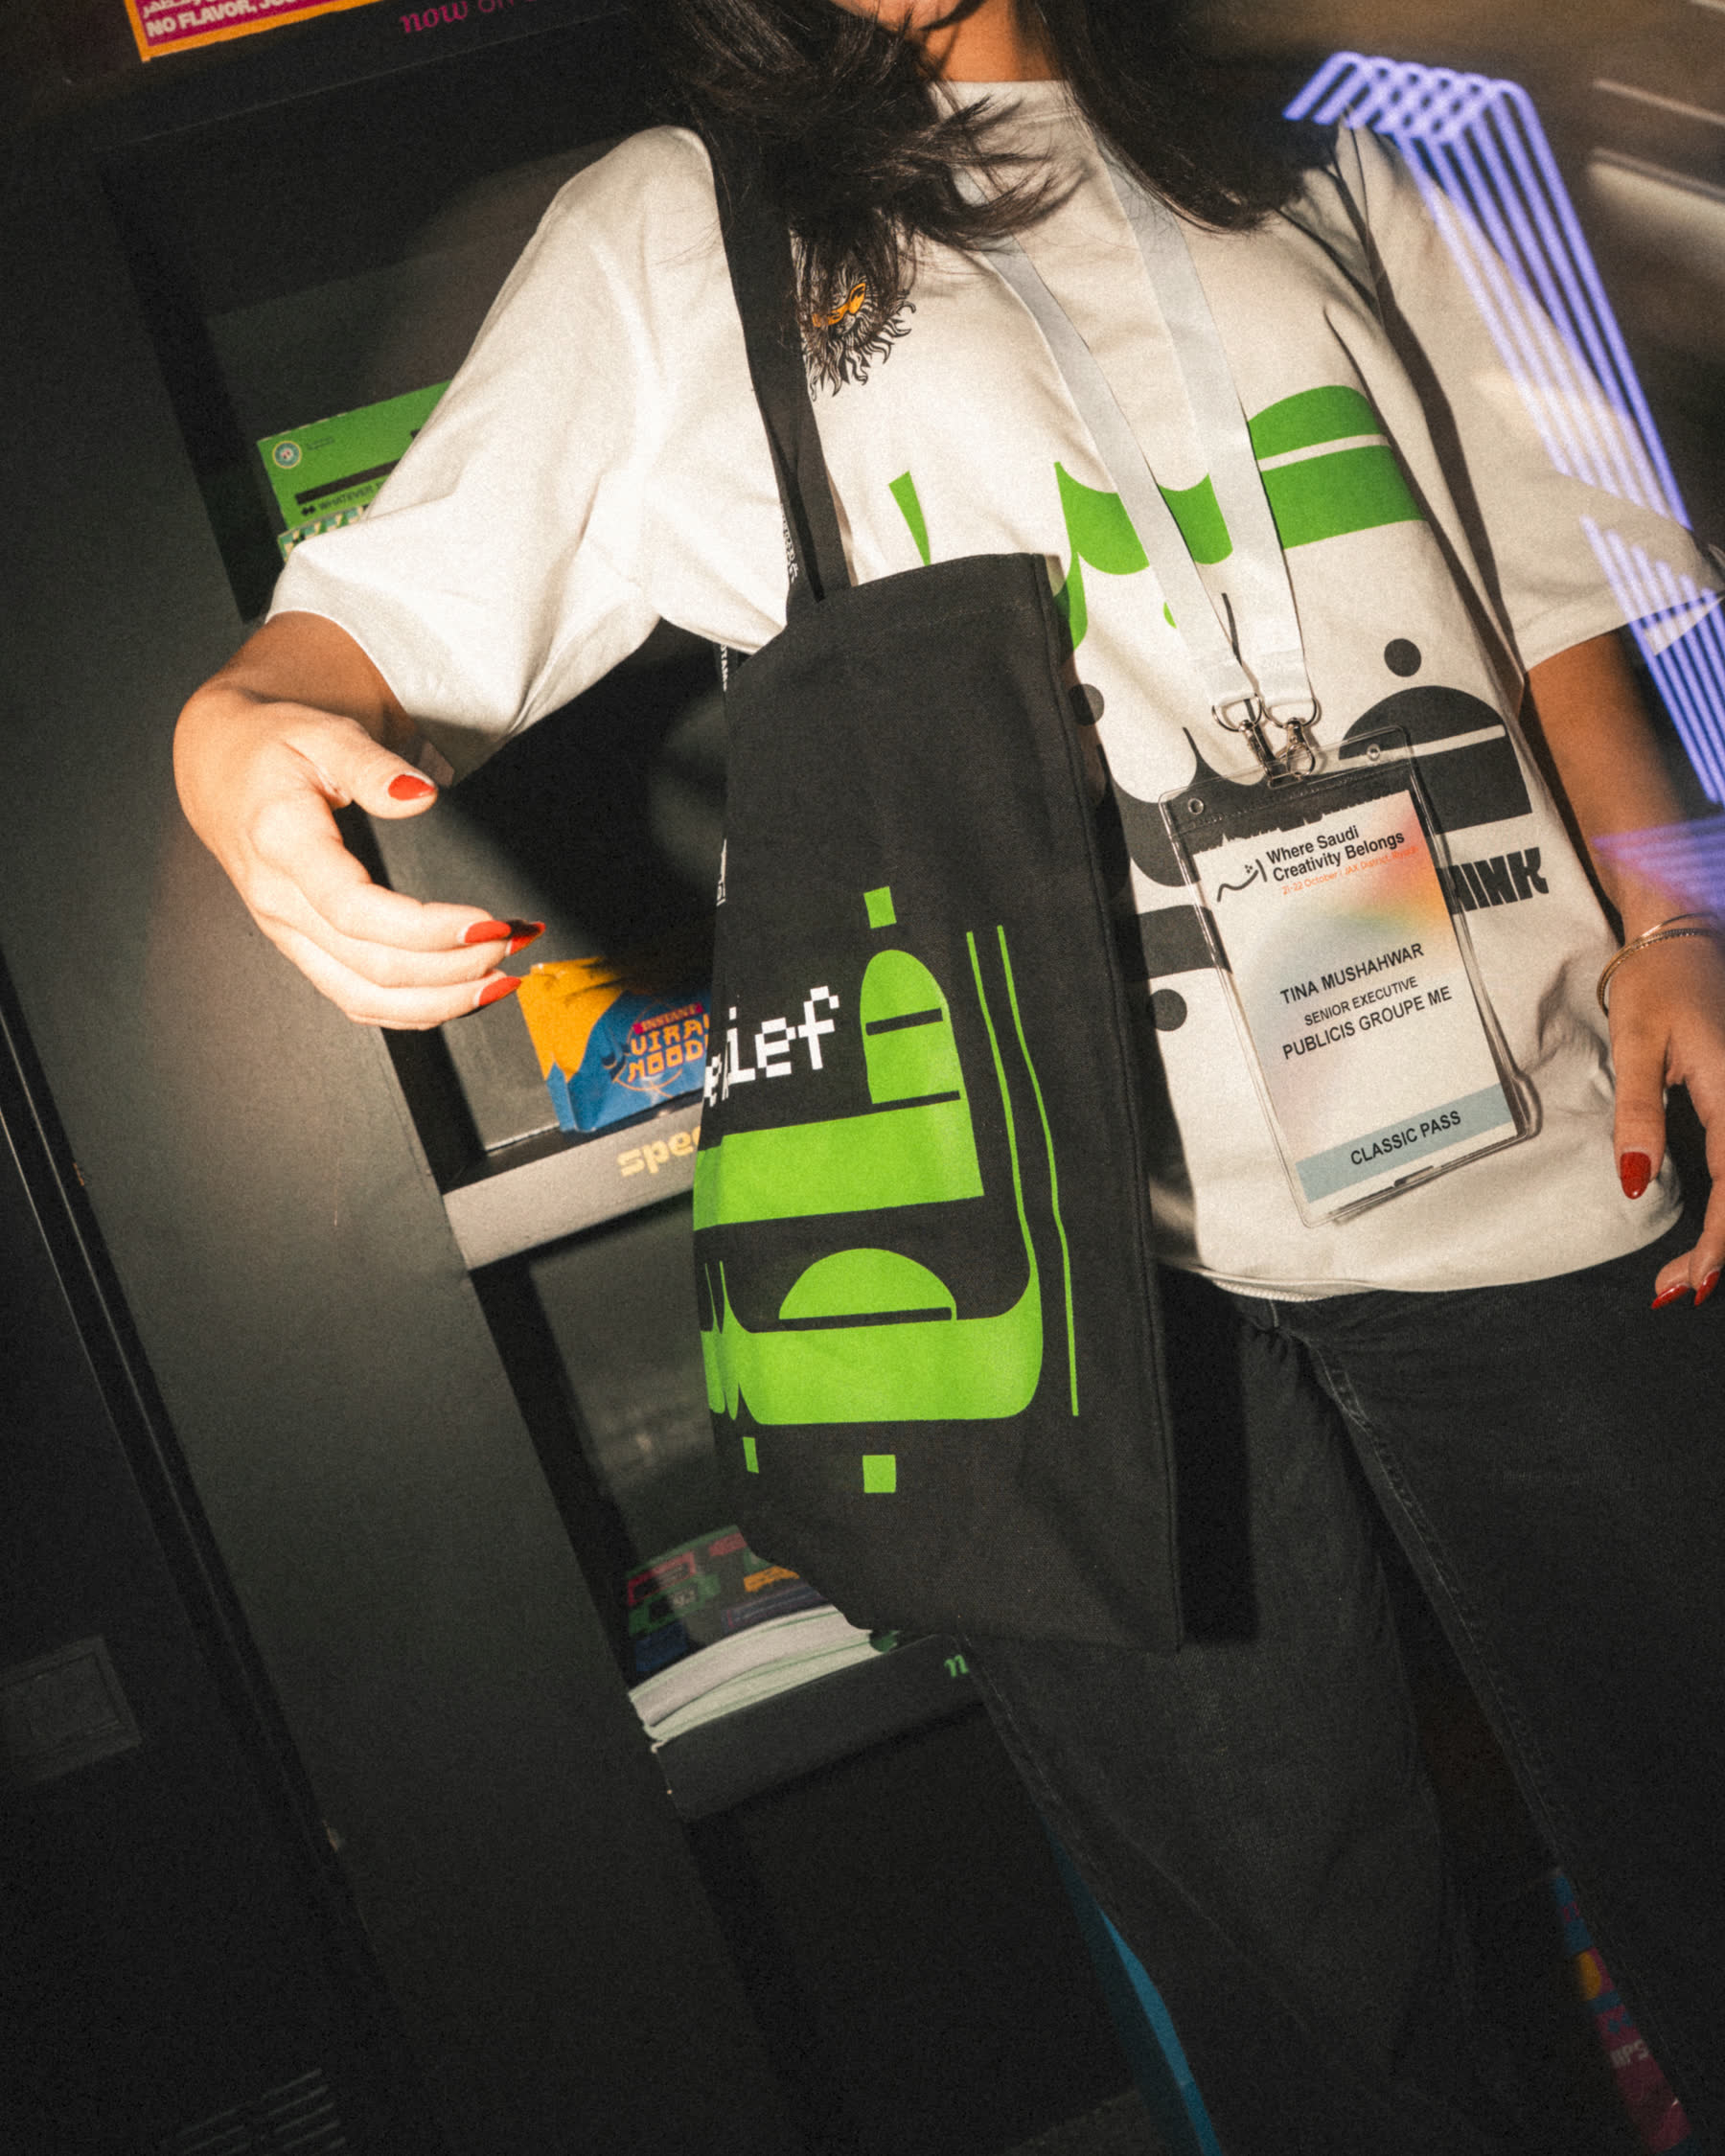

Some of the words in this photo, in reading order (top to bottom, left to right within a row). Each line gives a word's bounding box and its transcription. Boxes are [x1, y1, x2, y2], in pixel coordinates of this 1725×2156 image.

[146, 17, 177, 37] NO
[400, 1, 469, 34] now
[1266, 841, 1315, 865] Where
[1317, 825, 1360, 850] Saudi
[1273, 851, 1342, 882] Creativity
[1345, 832, 1406, 860] Belongs
[1304, 871, 1339, 888] October
[1345, 863, 1360, 876] JAX
[1436, 847, 1550, 915] HINK
[1280, 980, 1320, 1004] TINA
[1321, 943, 1425, 991] MUSHAHWAR
[640, 1002, 697, 1031] INSTANT
[1282, 1021, 1356, 1060] PUBLICIS
[1359, 996, 1425, 1031] GROUPE
[1427, 985, 1453, 1006] ME
[1304, 1000, 1351, 1026] SENIOR
[1352, 975, 1418, 1010] EXECUTIVE
[627, 1034, 709, 1084] NOOD
[1350, 1127, 1418, 1165] CLASSIC
[1419, 1110, 1461, 1138] PASS
